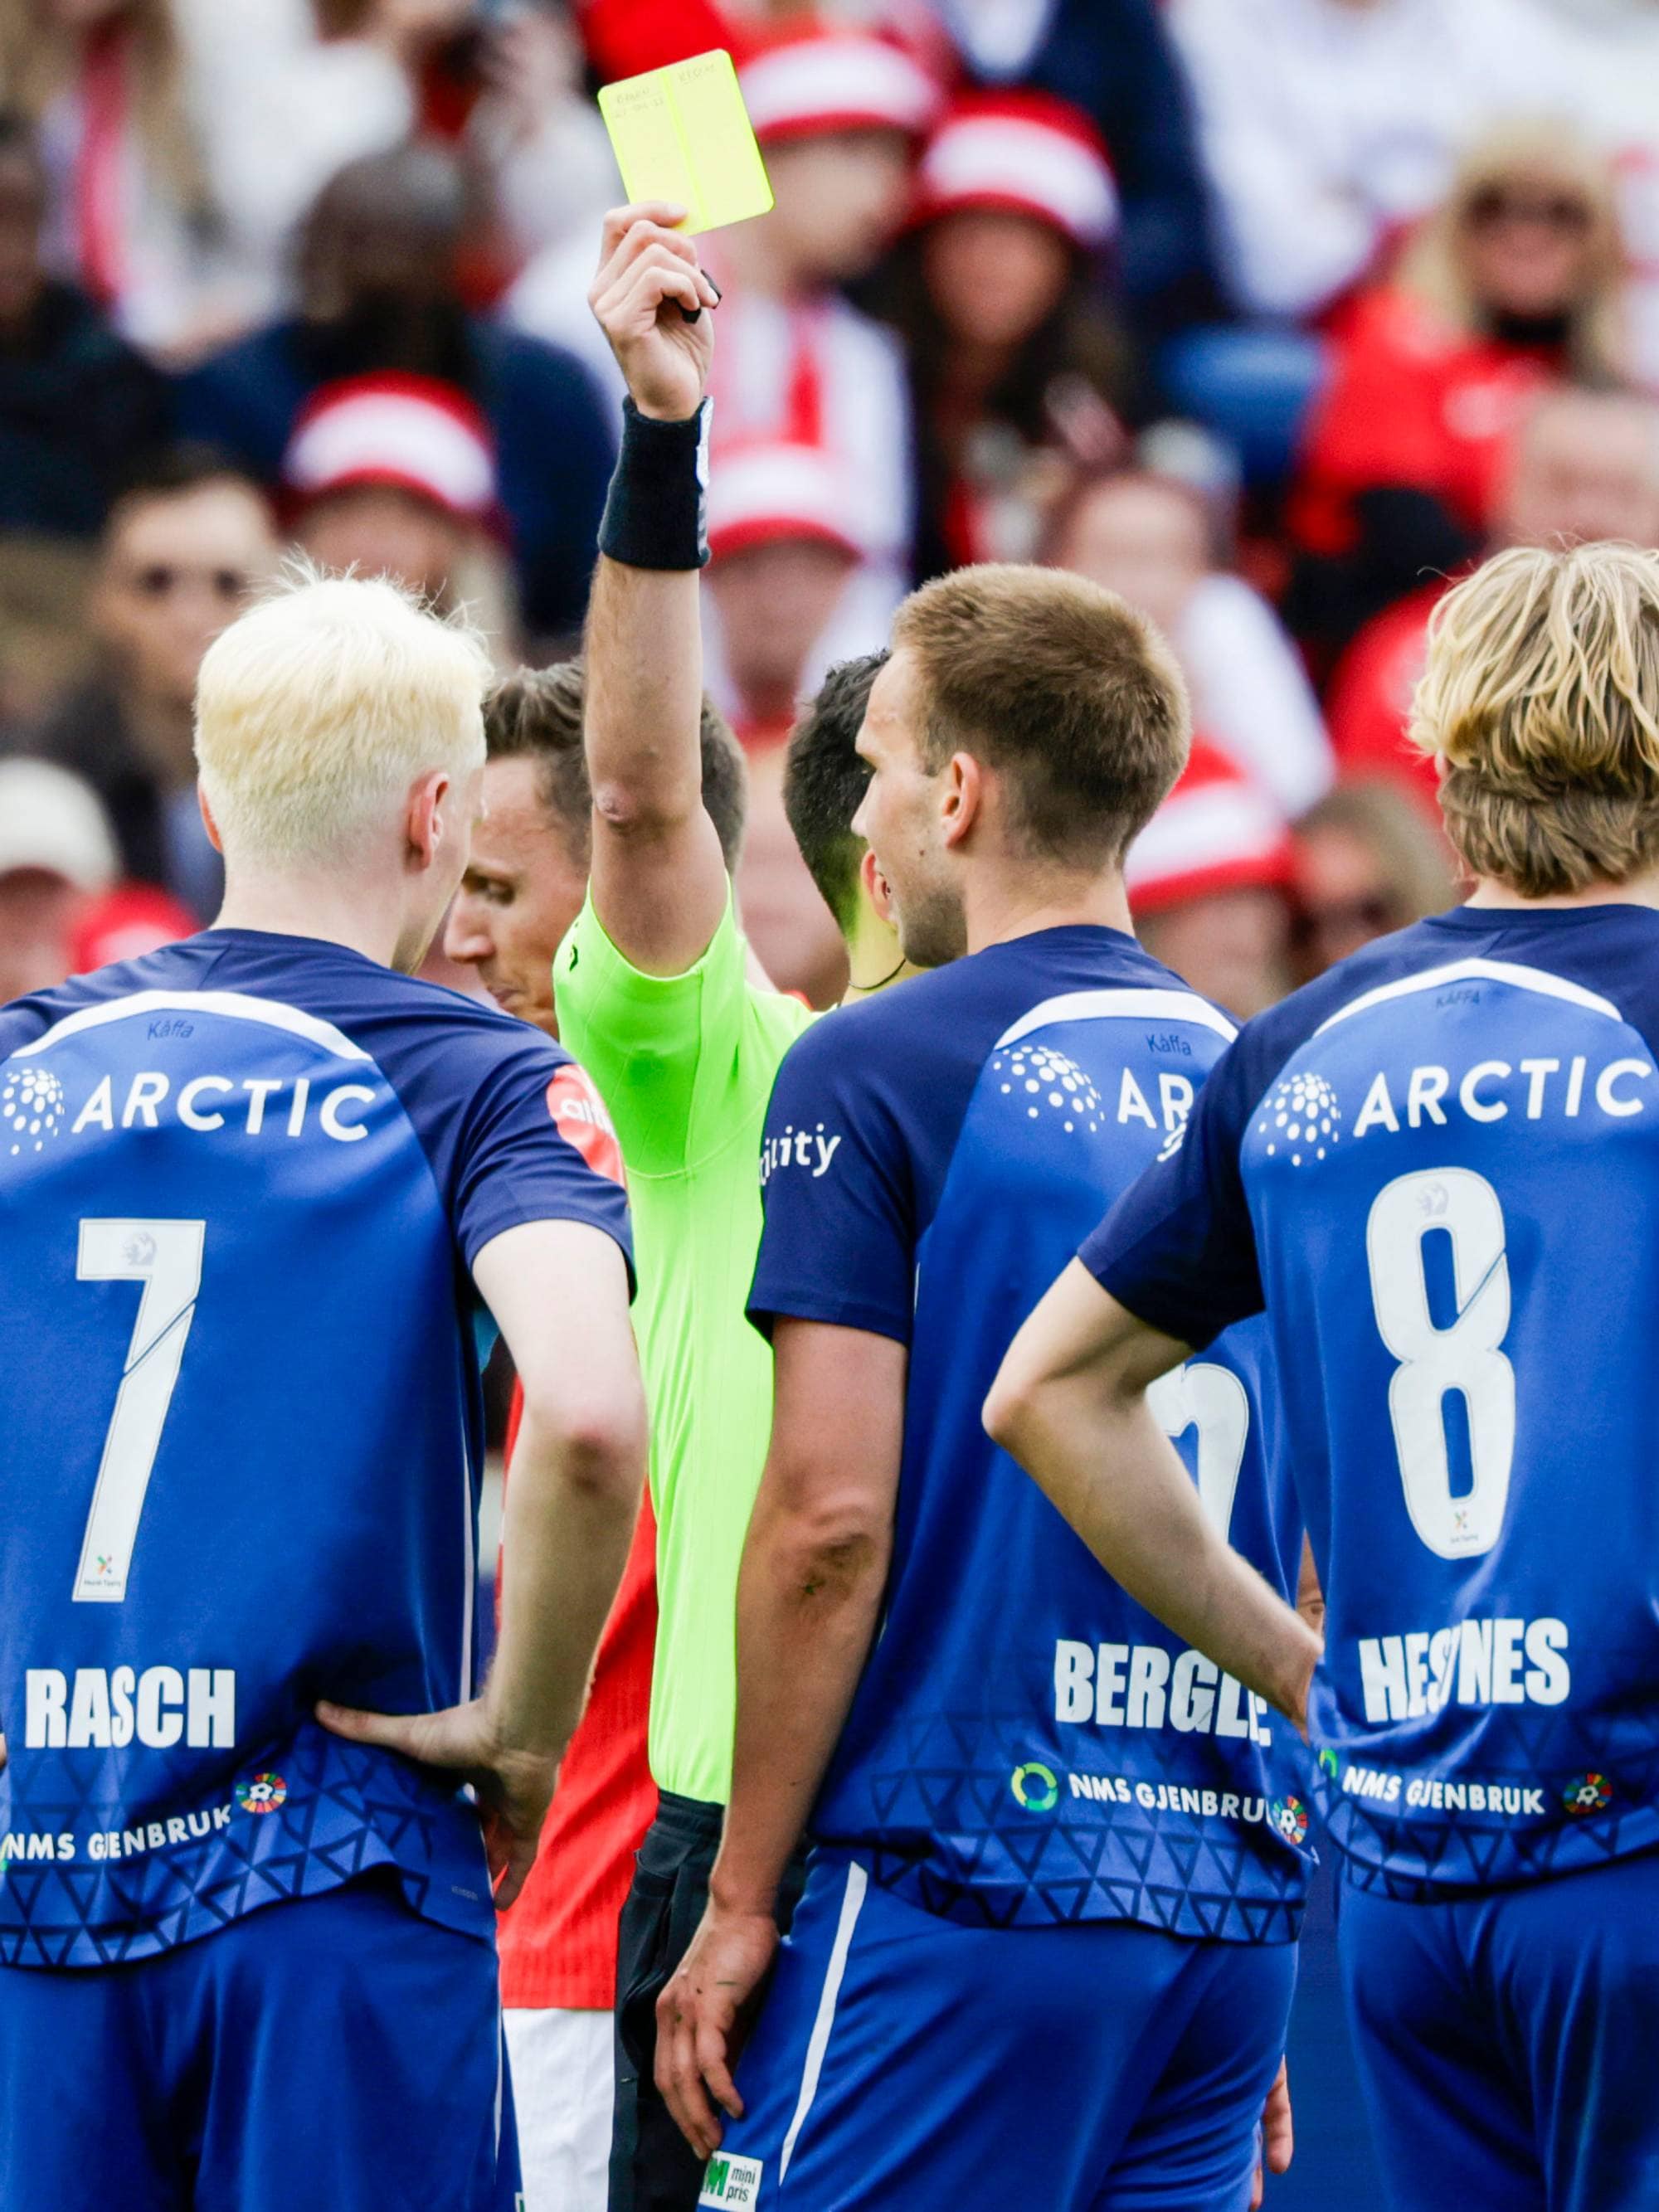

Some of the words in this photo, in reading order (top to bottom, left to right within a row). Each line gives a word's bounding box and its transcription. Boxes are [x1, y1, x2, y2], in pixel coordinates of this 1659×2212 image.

[71, 1072, 376, 1142] ARCTIC
[1117, 1067, 1194, 1131] AR
[1353, 1056, 1652, 1137] ARCTIC
[1366, 1166, 1515, 1560] 8
[71, 1218, 207, 1602] 7
[25, 1665, 236, 1748] RASCH
[1068, 1772, 1131, 1804] NMS
[1136, 1782, 1274, 1826] GJENBRU
[1342, 1766, 1403, 1802] NMS
[1406, 1778, 1546, 1816] GJENBRUK
[7, 1832, 76, 1861] NMS
[725, 2182, 750, 2203] pris
[731, 2165, 757, 2185] mini
